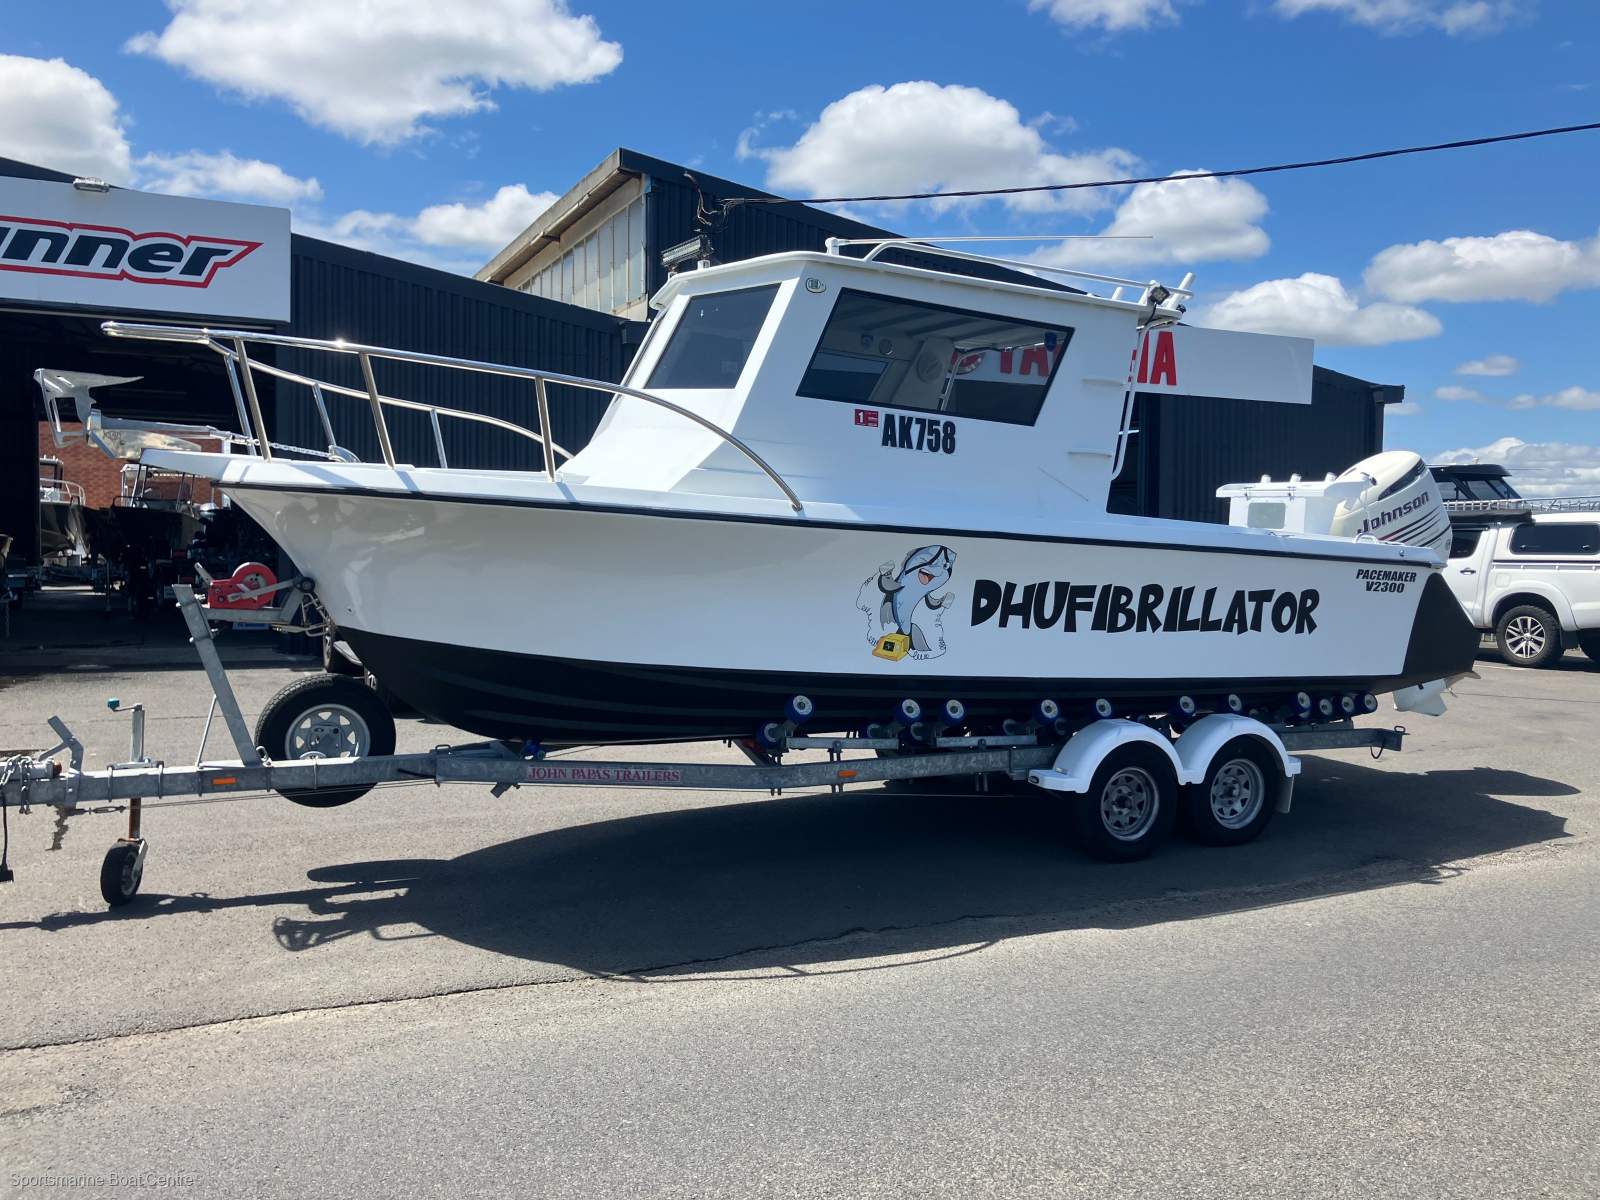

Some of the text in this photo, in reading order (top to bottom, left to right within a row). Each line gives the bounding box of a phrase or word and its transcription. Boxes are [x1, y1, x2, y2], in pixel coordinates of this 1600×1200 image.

[882, 413, 956, 455] AK758
[1357, 491, 1430, 535] Johnson
[1356, 568, 1417, 583] PACEMAKER
[1365, 581, 1405, 594] V2300
[971, 579, 1321, 635] DHUFIBRILLATOR
[528, 767, 681, 782] JOHN PAPAS TRAILERS
